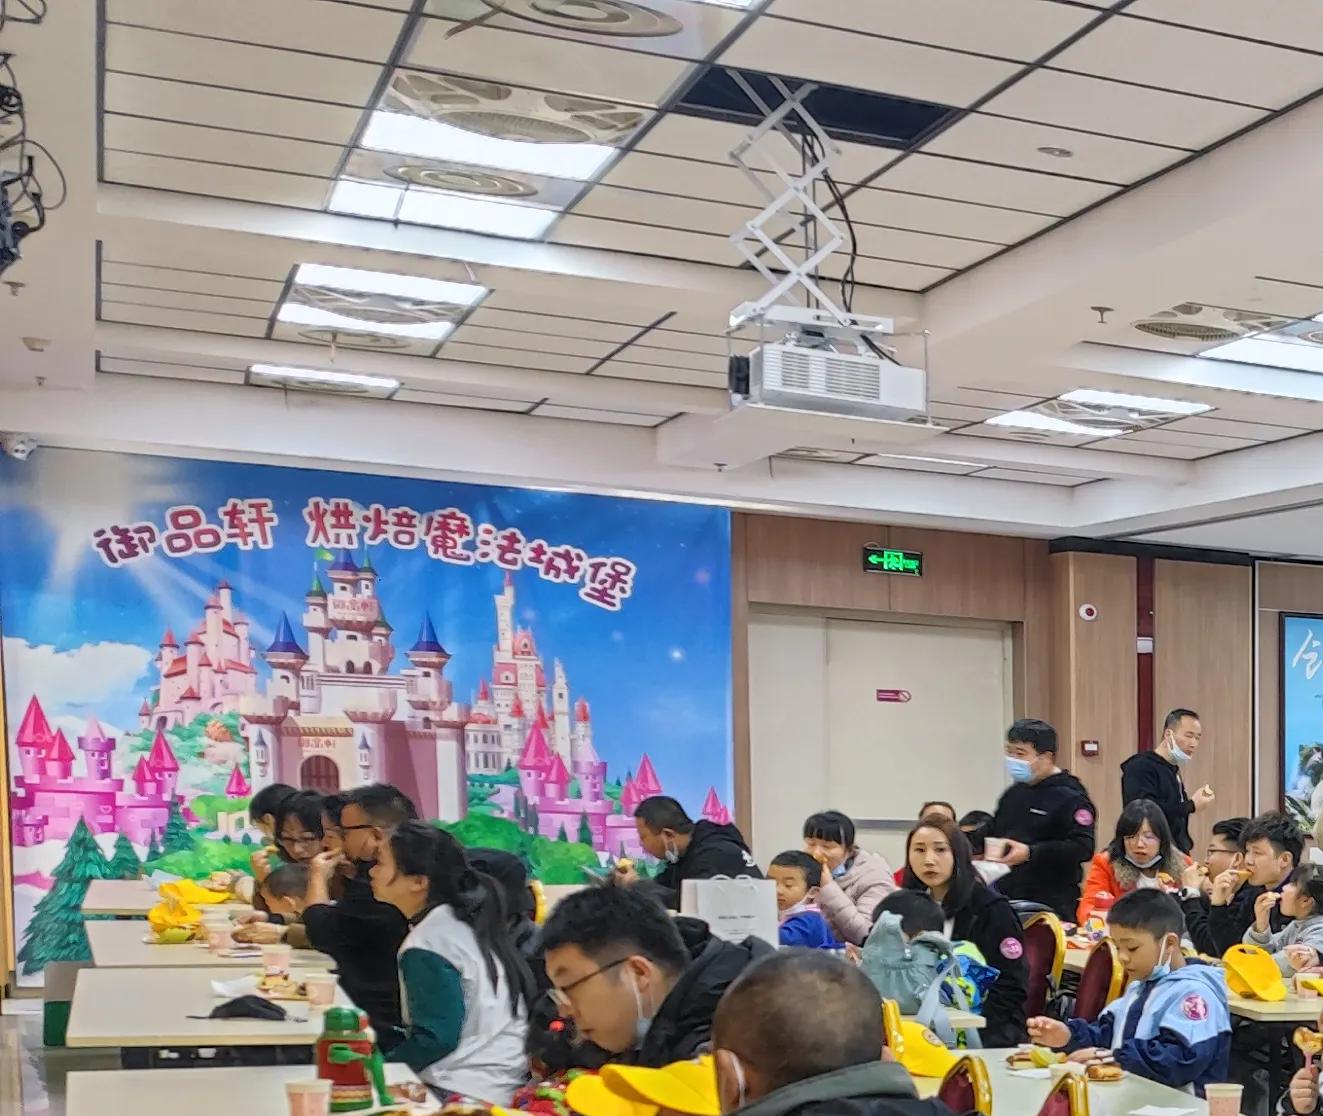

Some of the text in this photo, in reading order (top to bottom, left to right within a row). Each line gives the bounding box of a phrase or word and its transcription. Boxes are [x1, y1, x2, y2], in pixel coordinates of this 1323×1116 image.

[95, 499, 636, 610] 御品轩 烘焙魔法城堡
